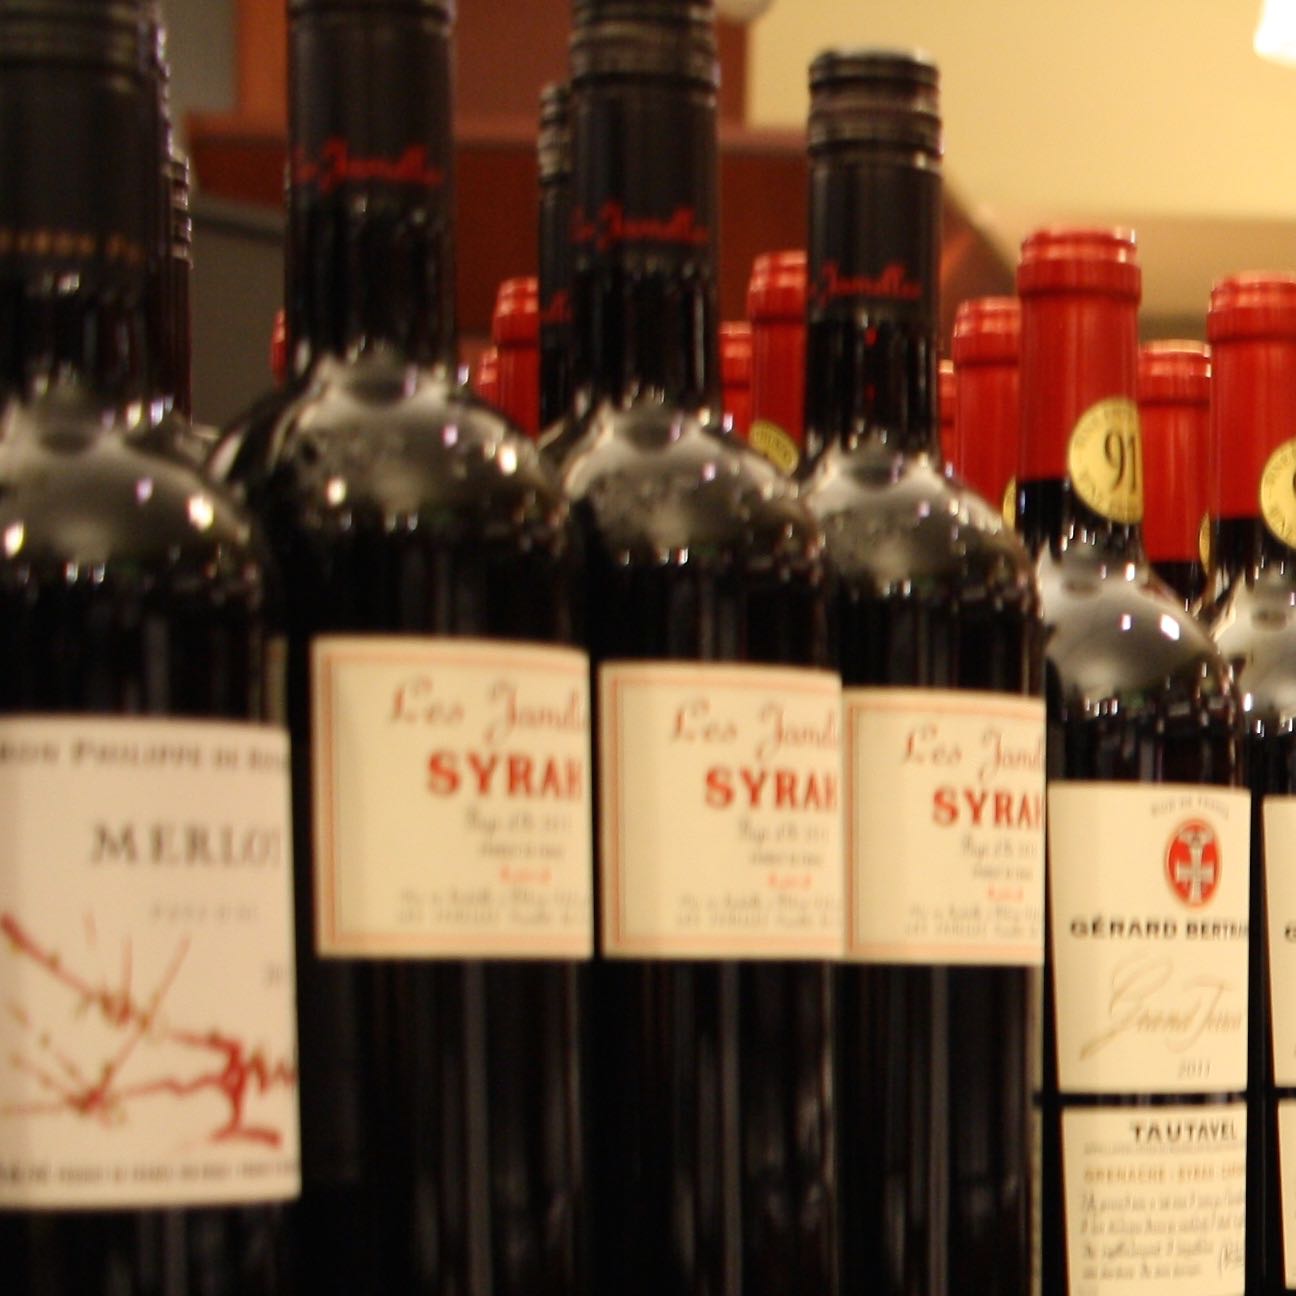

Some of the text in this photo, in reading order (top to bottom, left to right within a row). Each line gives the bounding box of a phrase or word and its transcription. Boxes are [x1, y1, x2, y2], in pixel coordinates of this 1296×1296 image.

[1105, 430, 1138, 493] 91
[1069, 914, 1178, 941] GÉRARD
[1131, 1119, 1238, 1144] TAUTAVEL
